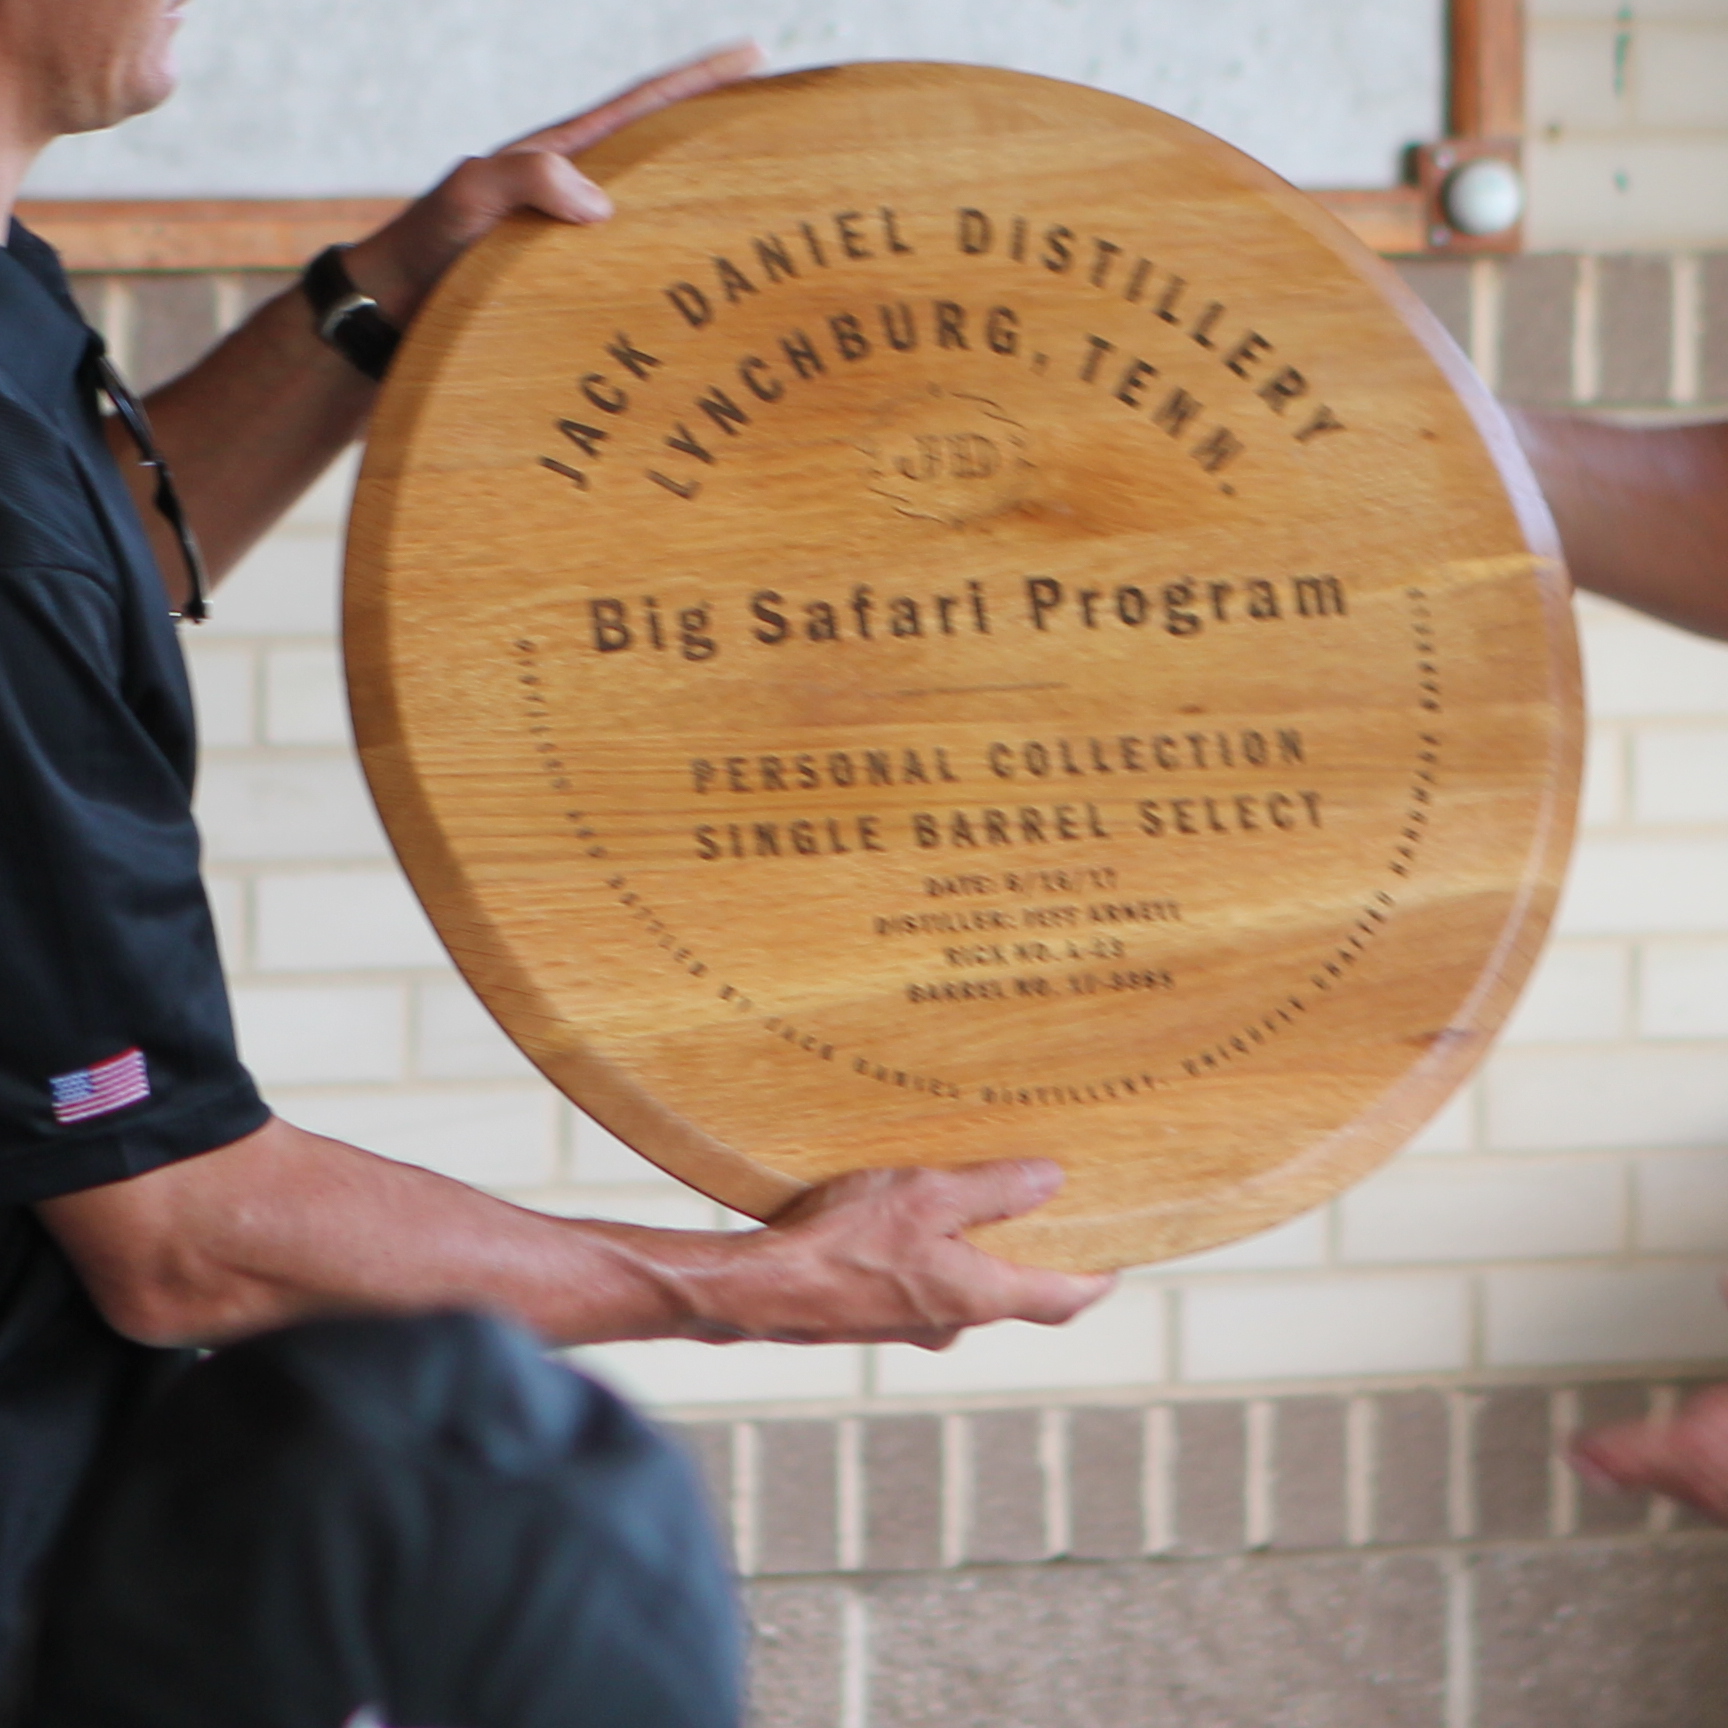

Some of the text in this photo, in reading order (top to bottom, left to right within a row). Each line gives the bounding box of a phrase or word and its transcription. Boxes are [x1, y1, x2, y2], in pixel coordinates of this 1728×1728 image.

[537, 205, 1347, 492] JACK DANIEL DISTILLERY
[645, 299, 1248, 500] LYNCHBURG, TENN.
[588, 573, 1351, 663] Big Safari Program
[688, 728, 1310, 794] PERSONAL COLLECTION
[694, 790, 1326, 862] SINGLE BARREL SELECT
